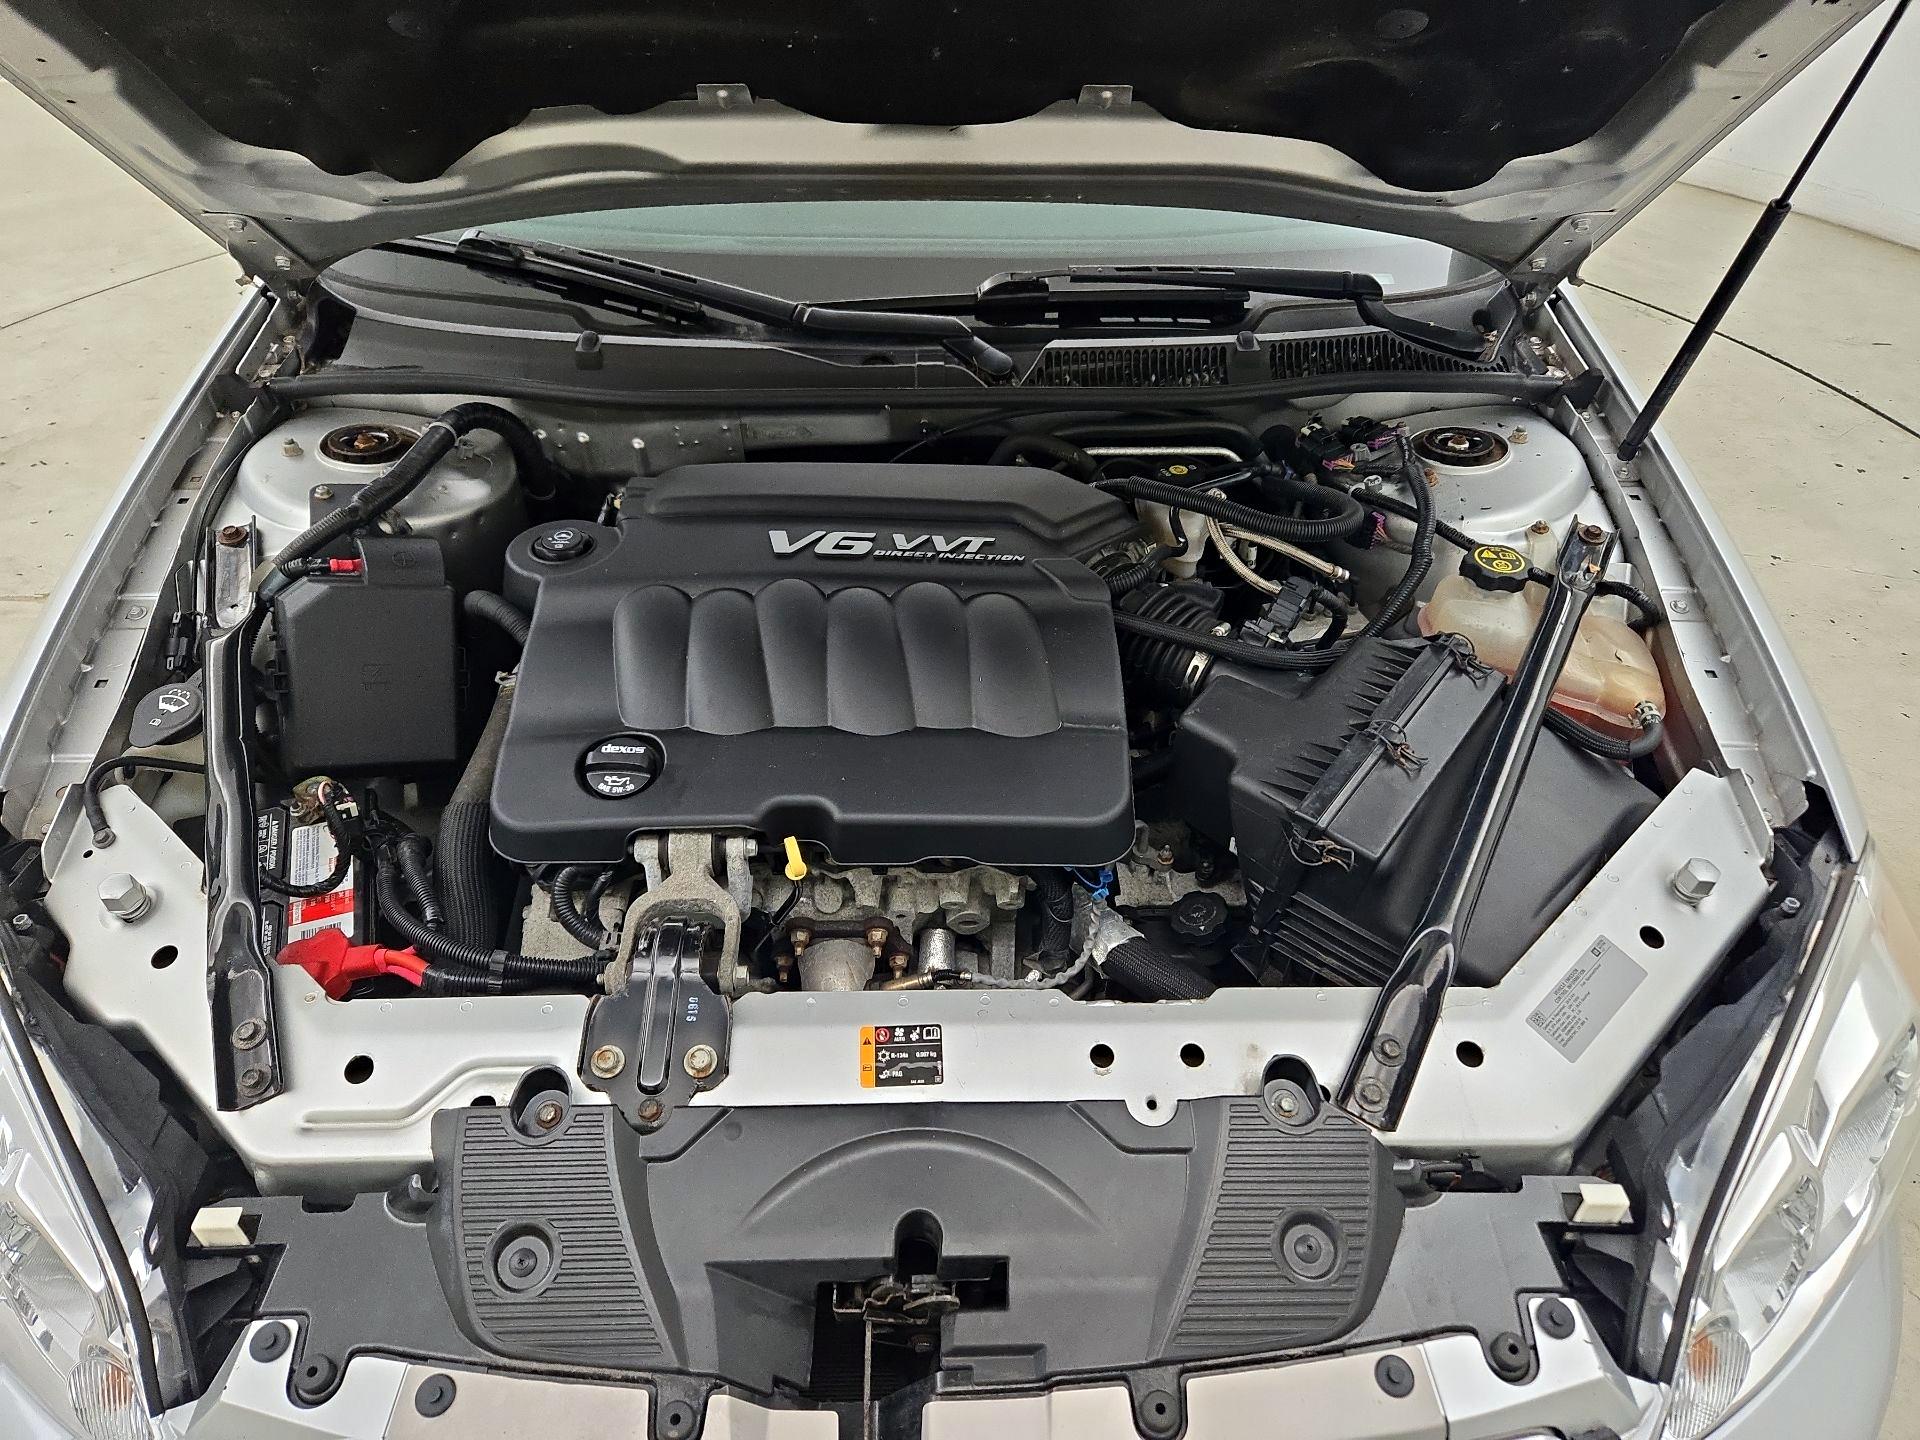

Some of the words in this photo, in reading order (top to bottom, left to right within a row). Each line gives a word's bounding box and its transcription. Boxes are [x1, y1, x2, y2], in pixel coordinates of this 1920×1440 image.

[768, 530, 877, 556] V6
[892, 533, 996, 553] VVT
[873, 549, 936, 559] DIRECT
[938, 552, 1026, 561] INJECTION
[601, 744, 646, 753] dexos
[597, 782, 611, 792] SAE
[612, 784, 635, 793] 5W-30
[271, 825, 279, 846] DANGER
